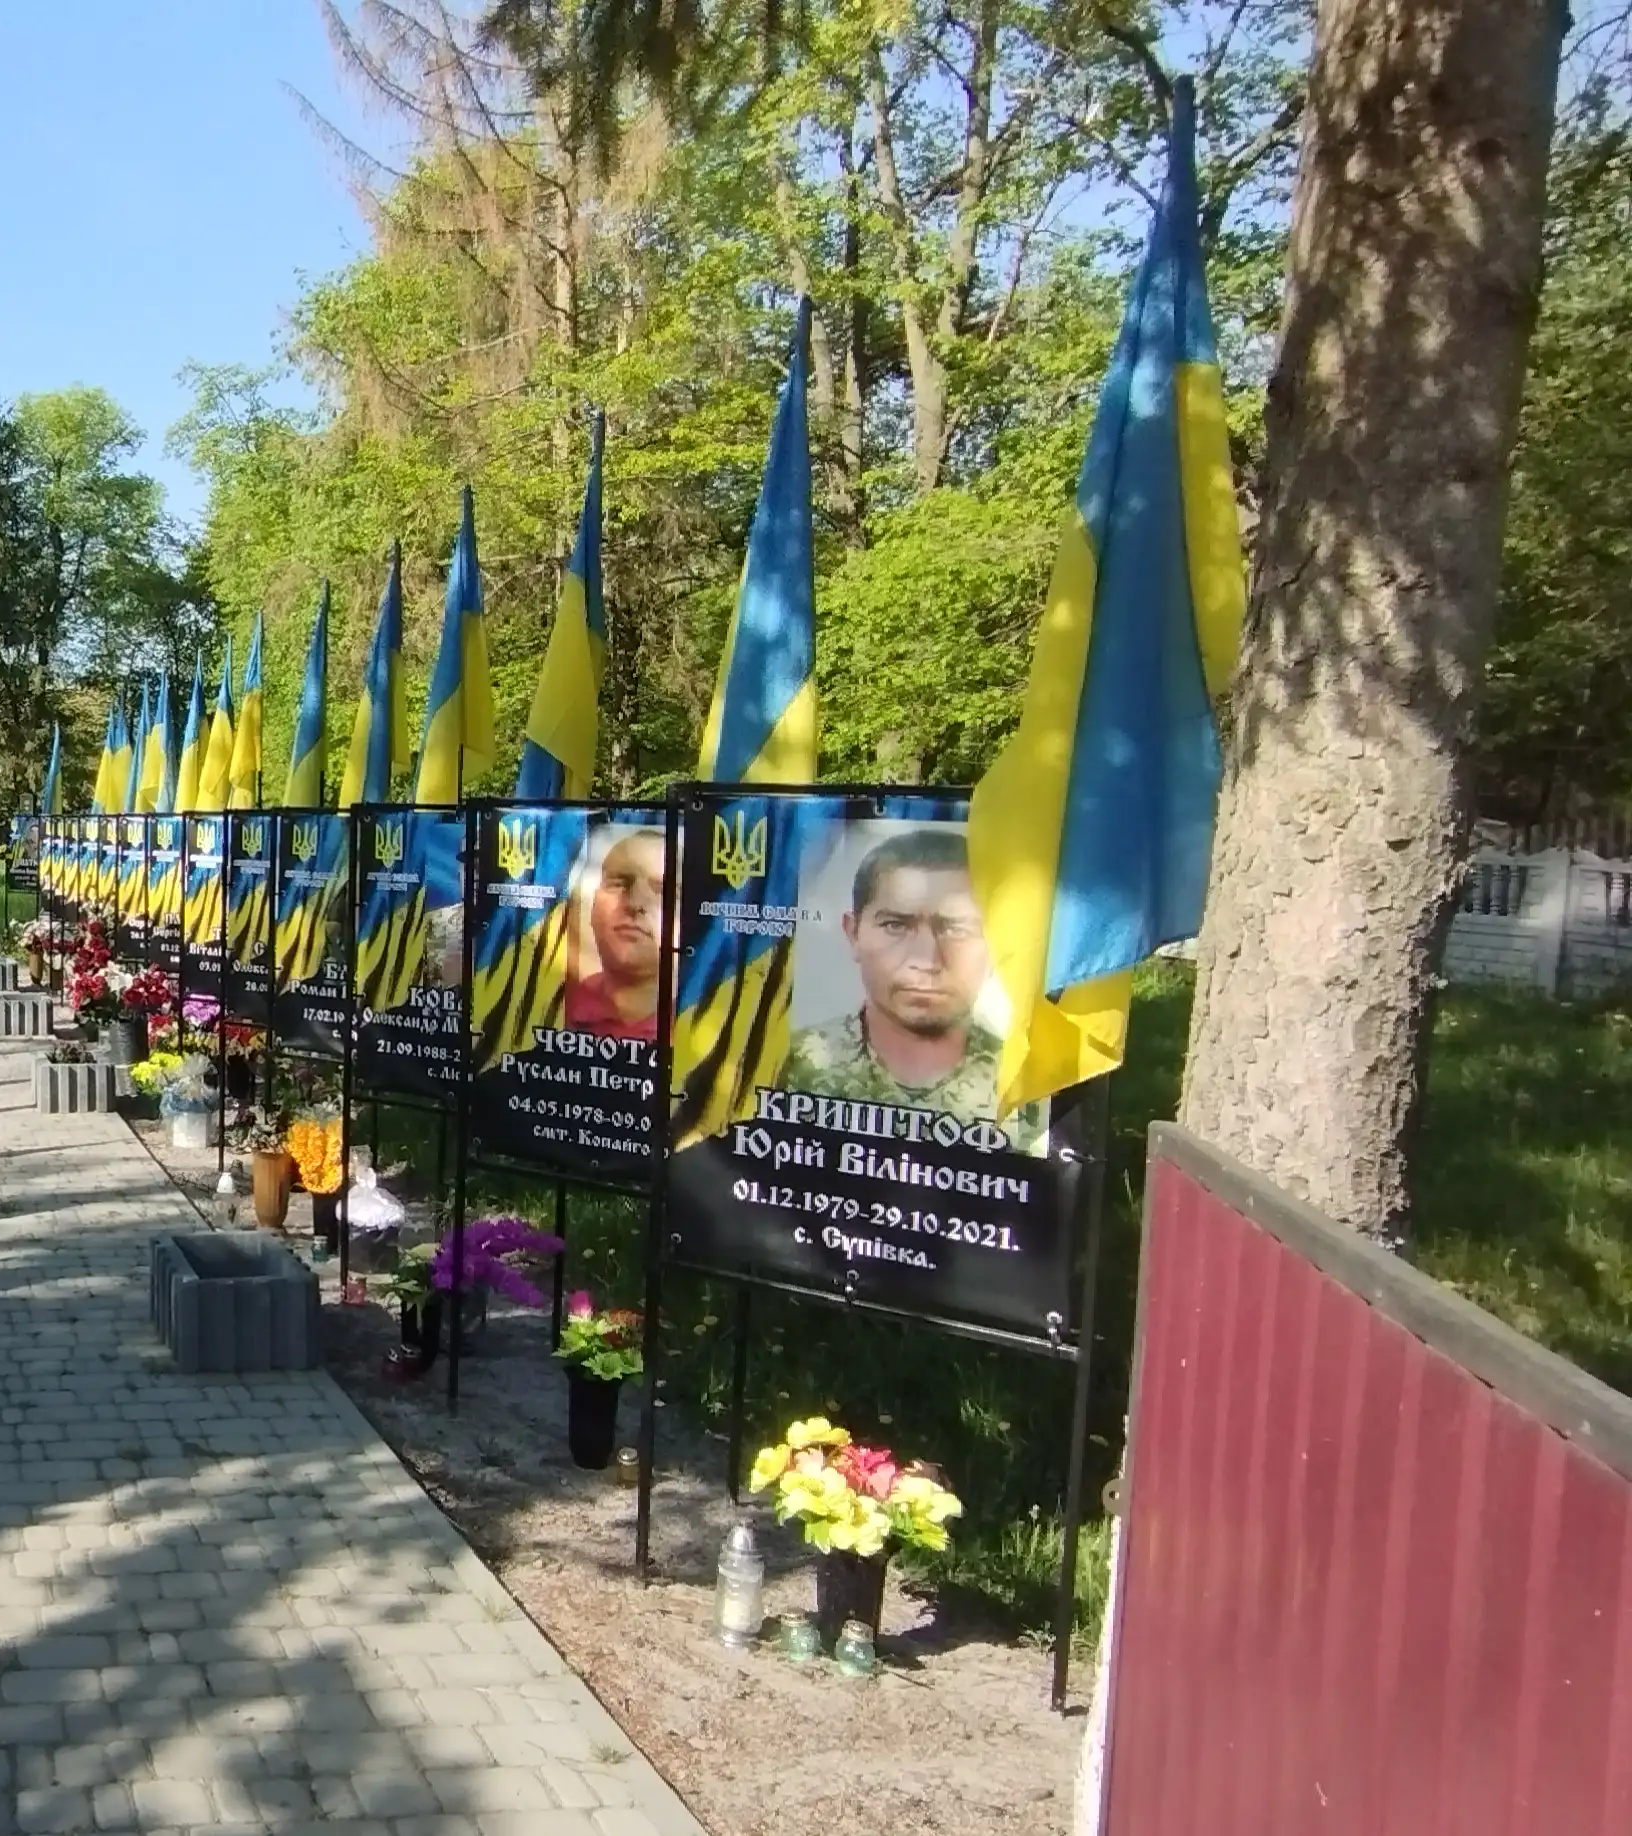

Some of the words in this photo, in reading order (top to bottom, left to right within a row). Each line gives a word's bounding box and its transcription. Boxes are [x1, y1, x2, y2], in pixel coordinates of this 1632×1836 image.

[290, 980, 337, 998] Роман
[363, 1006, 438, 1035] Олександр
[500, 1053, 582, 1084] Руслан
[756, 1088, 1010, 1153] КРИШТОФ
[732, 1125, 825, 1170] Юрій
[837, 1142, 1029, 1203] Вілінович
[733, 1178, 1021, 1251] 01.12.1979-29.10.2021.
[793, 1226, 813, 1244] с.
[822, 1225, 937, 1270] Супівка.
